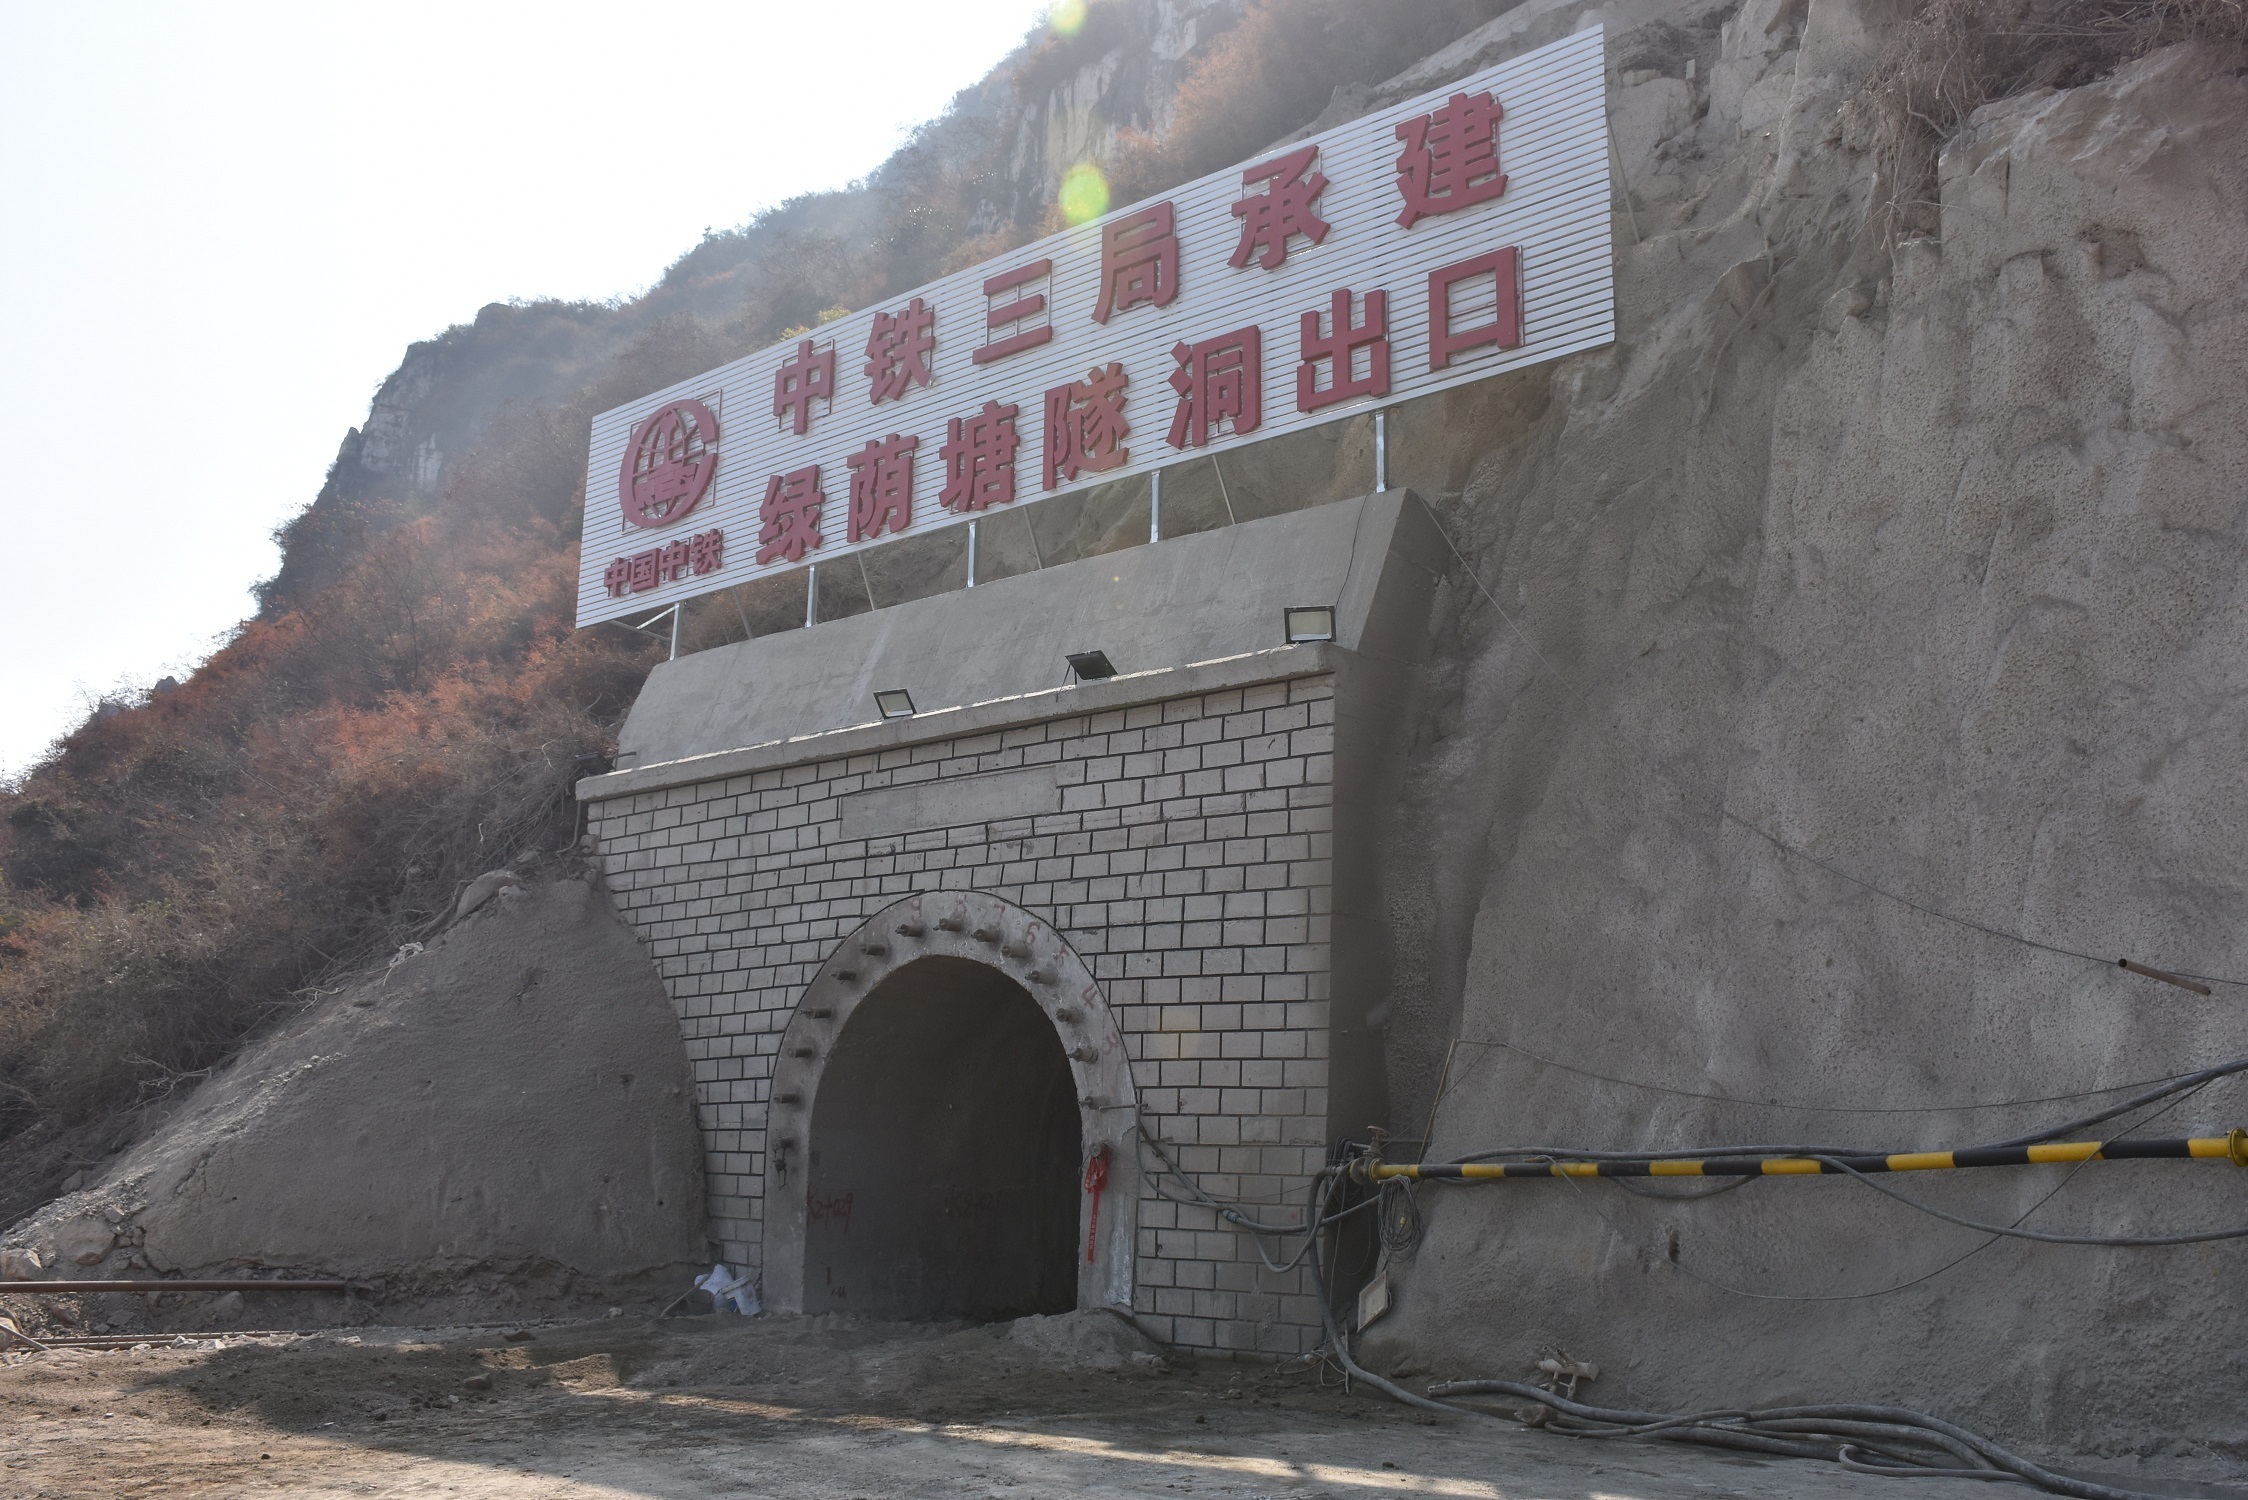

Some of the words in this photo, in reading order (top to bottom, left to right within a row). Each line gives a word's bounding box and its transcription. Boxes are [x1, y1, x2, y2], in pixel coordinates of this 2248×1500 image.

[755, 246, 1519, 565] 绿荫塘隧洞出口
[773, 91, 1508, 436] 中铁三局承建
[603, 528, 724, 597] 中国中铁
